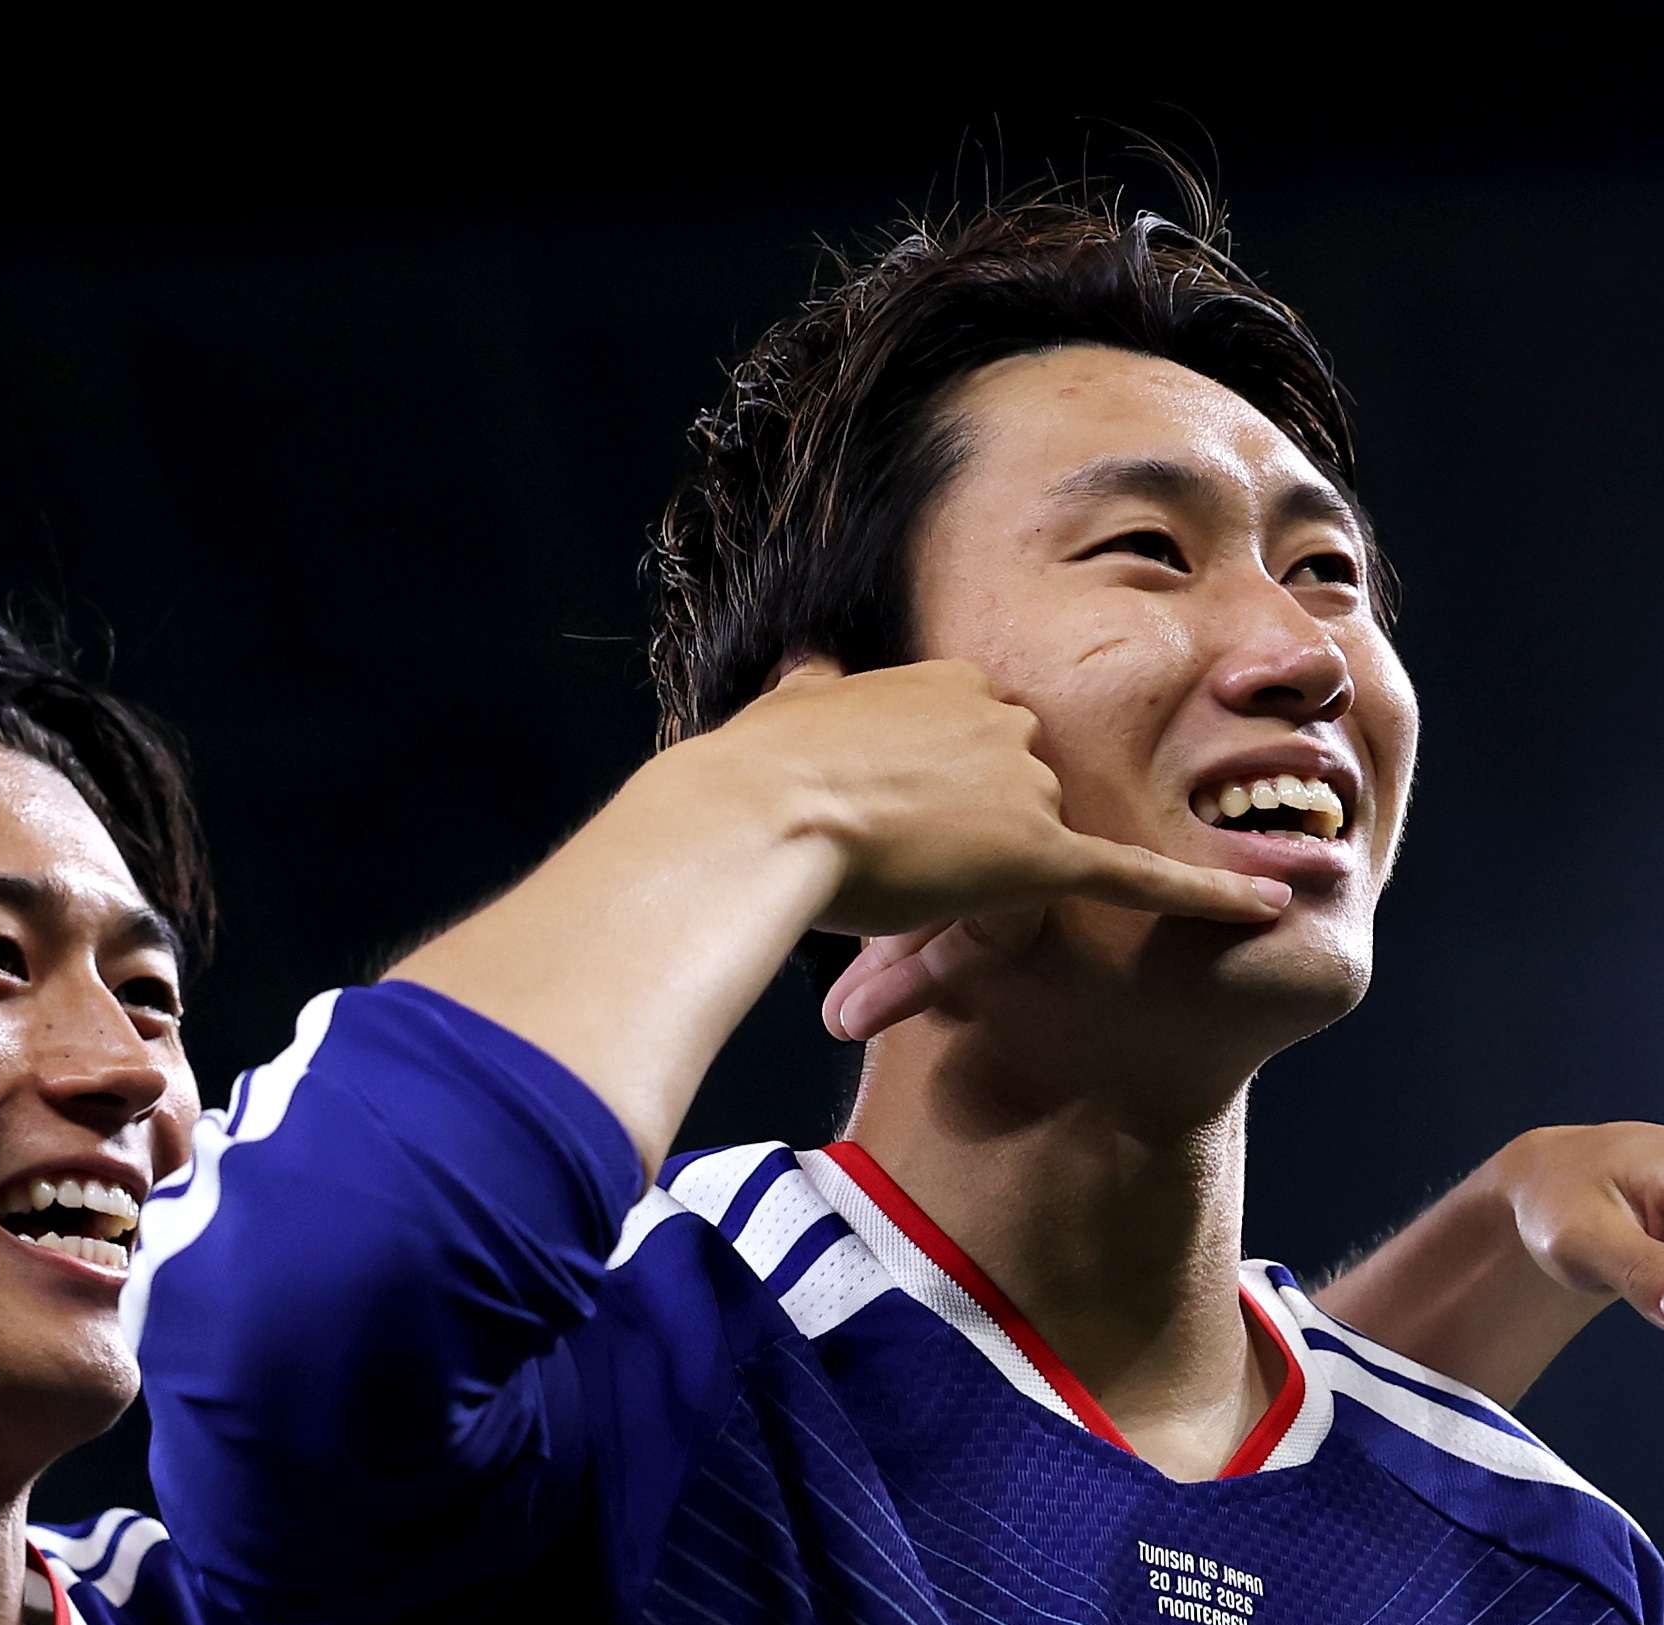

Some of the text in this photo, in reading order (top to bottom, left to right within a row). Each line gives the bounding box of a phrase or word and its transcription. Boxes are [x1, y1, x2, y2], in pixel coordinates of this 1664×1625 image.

[1138, 1541, 1194, 1574] TUNISIA
[1223, 1565, 1264, 1597] JAPAN
[1149, 1569, 1254, 1616] 20 JUNE 2026
